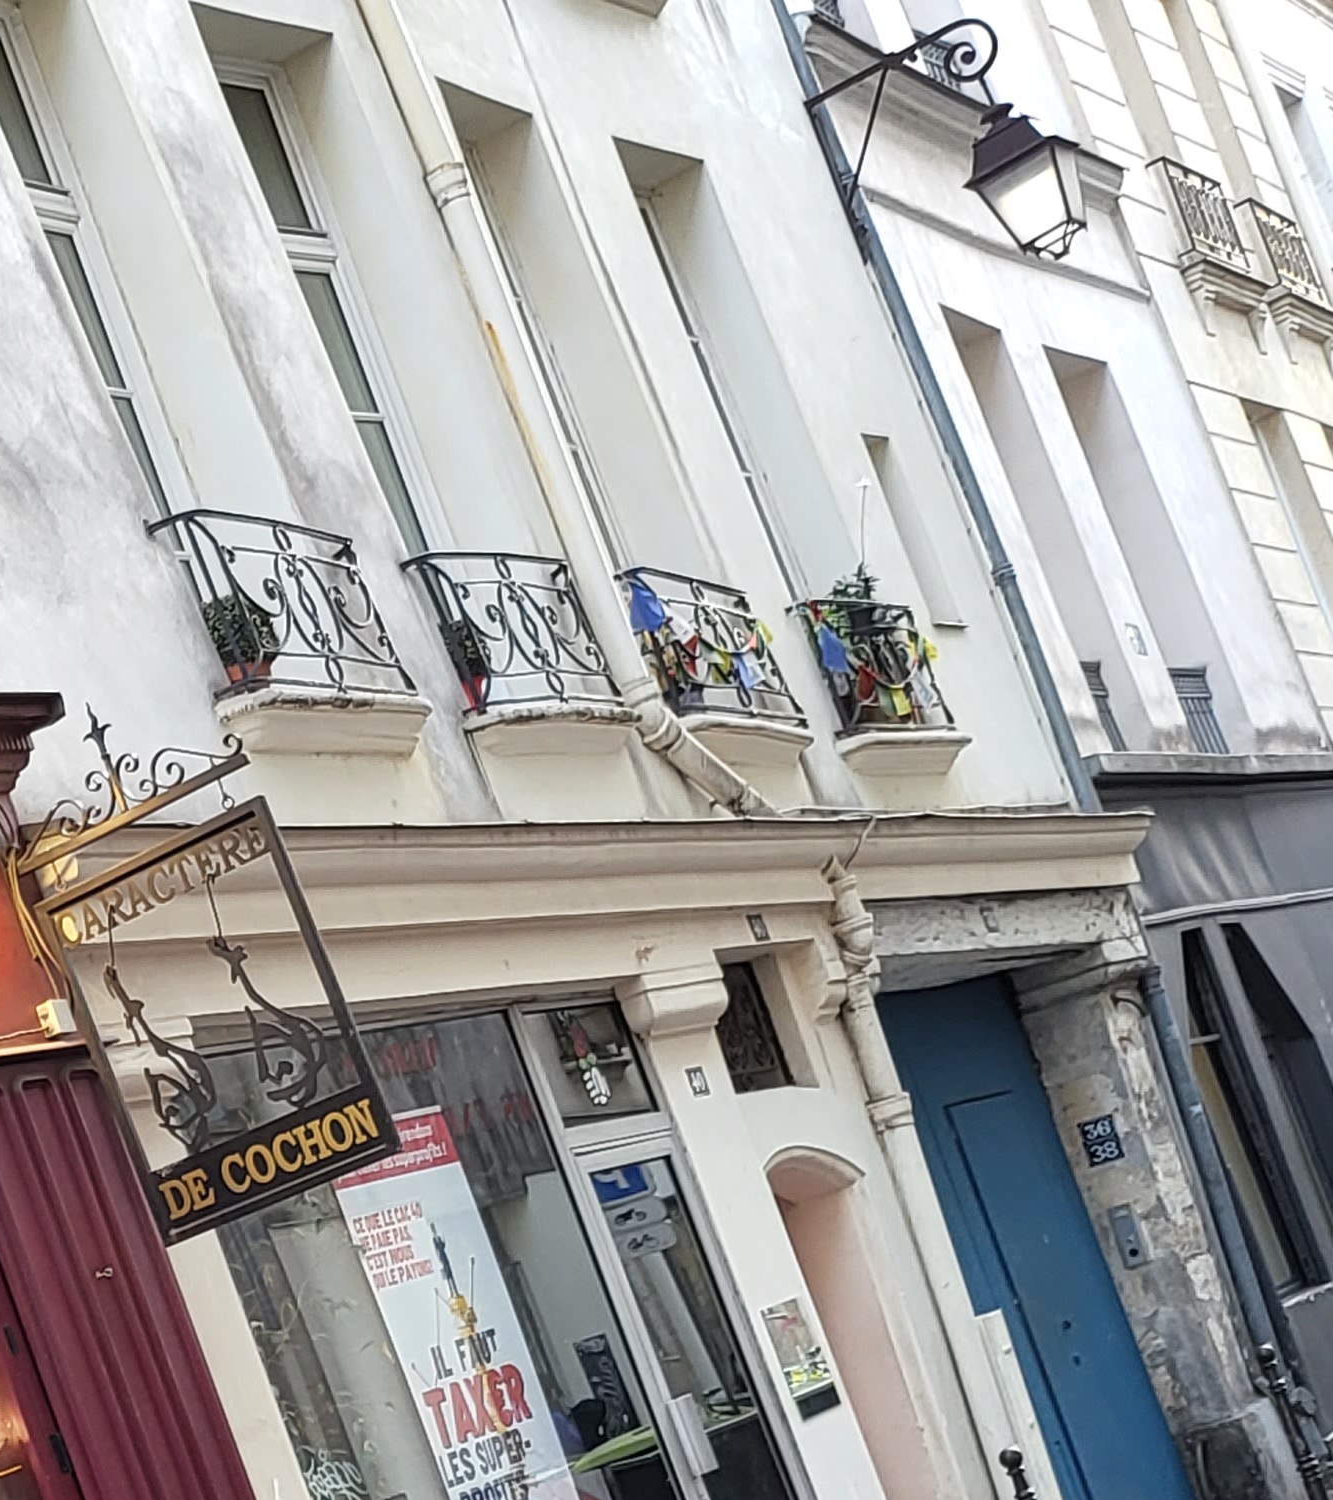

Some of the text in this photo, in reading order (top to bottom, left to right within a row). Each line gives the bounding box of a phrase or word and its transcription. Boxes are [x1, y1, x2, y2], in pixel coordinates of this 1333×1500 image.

[55, 823, 268, 948] CARACTERE
[1084, 1121, 1111, 1139] 36
[159, 1172, 216, 1219] DE
[221, 1099, 380, 1192] COCHON
[1090, 1141, 1119, 1162] 38
[365, 1211, 383, 1232] QUE
[382, 1207, 395, 1228] LE
[371, 1231, 393, 1250] PAIE
[393, 1225, 413, 1244] PAS
[366, 1244, 415, 1271] C'EST NOUS
[385, 1269, 399, 1287] LE
[431, 1328, 498, 1380] IL FAUT
[422, 1363, 533, 1450] TAXER
[438, 1428, 532, 1489] LES SUPER-
